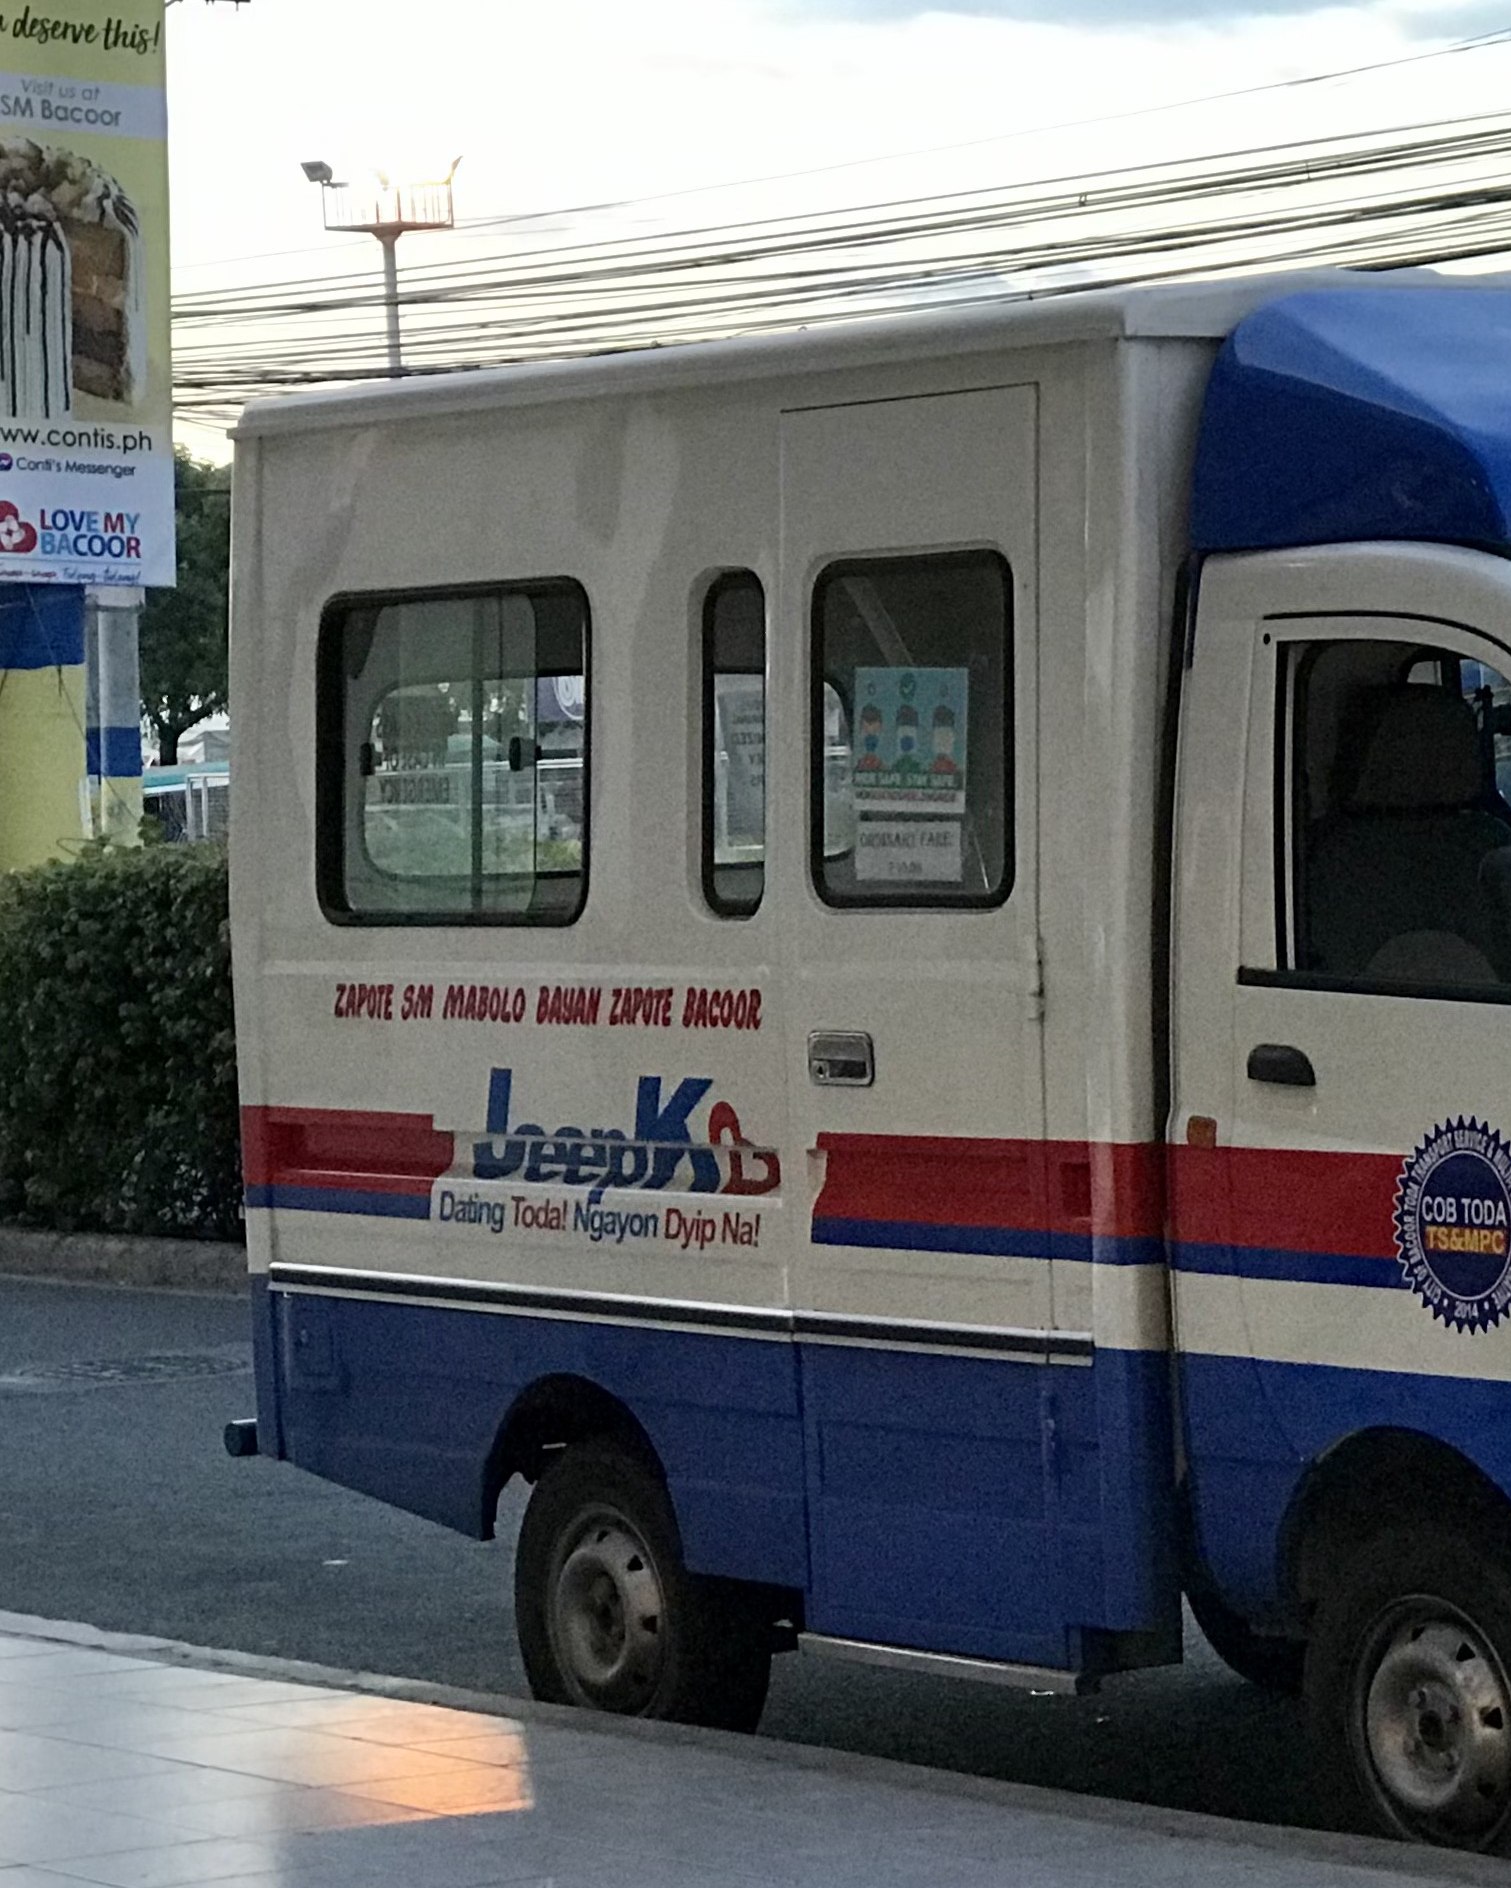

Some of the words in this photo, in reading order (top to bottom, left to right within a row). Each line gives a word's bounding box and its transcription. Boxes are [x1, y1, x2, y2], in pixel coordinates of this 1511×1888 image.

[13, 5, 99, 44] deserve
[102, 17, 160, 55] this!
[21, 79, 54, 96] Visit
[59, 86, 76, 99] us
[82, 87, 101, 101] at
[0, 95, 34, 119] SM
[41, 98, 122, 127] Bacoor
[16, 457, 62, 473] Conti's
[65, 460, 136, 479] Messenger
[40, 508, 99, 532] LOVE
[104, 512, 140, 534] MY
[40, 532, 142, 558] BACOOR
[334, 983, 394, 1020] ZAPOTE
[400, 984, 434, 1020] SM
[442, 984, 526, 1024] MABOLO
[536, 986, 601, 1026] BAYAN
[609, 987, 673, 1027] ZAPOTE
[682, 987, 762, 1029] BACOOR
[1454, 1129, 1489, 1154] SERVICE
[1411, 1132, 1454, 1182] TRANSPORT
[1404, 1181, 1420, 1210] TODA
[440, 1190, 504, 1233] Dating
[511, 1196, 567, 1231] Toda!
[574, 1201, 658, 1244] Ngayon
[664, 1208, 715, 1250] Dyip
[721, 1211, 760, 1247] Na!
[1422, 1195, 1457, 1223] COB
[1461, 1197, 1507, 1227] TODA
[1403, 1215, 1421, 1264] BACOOR
[1426, 1225, 1504, 1255] TS&MPC
[1454, 1301, 1478, 1319] 2014
